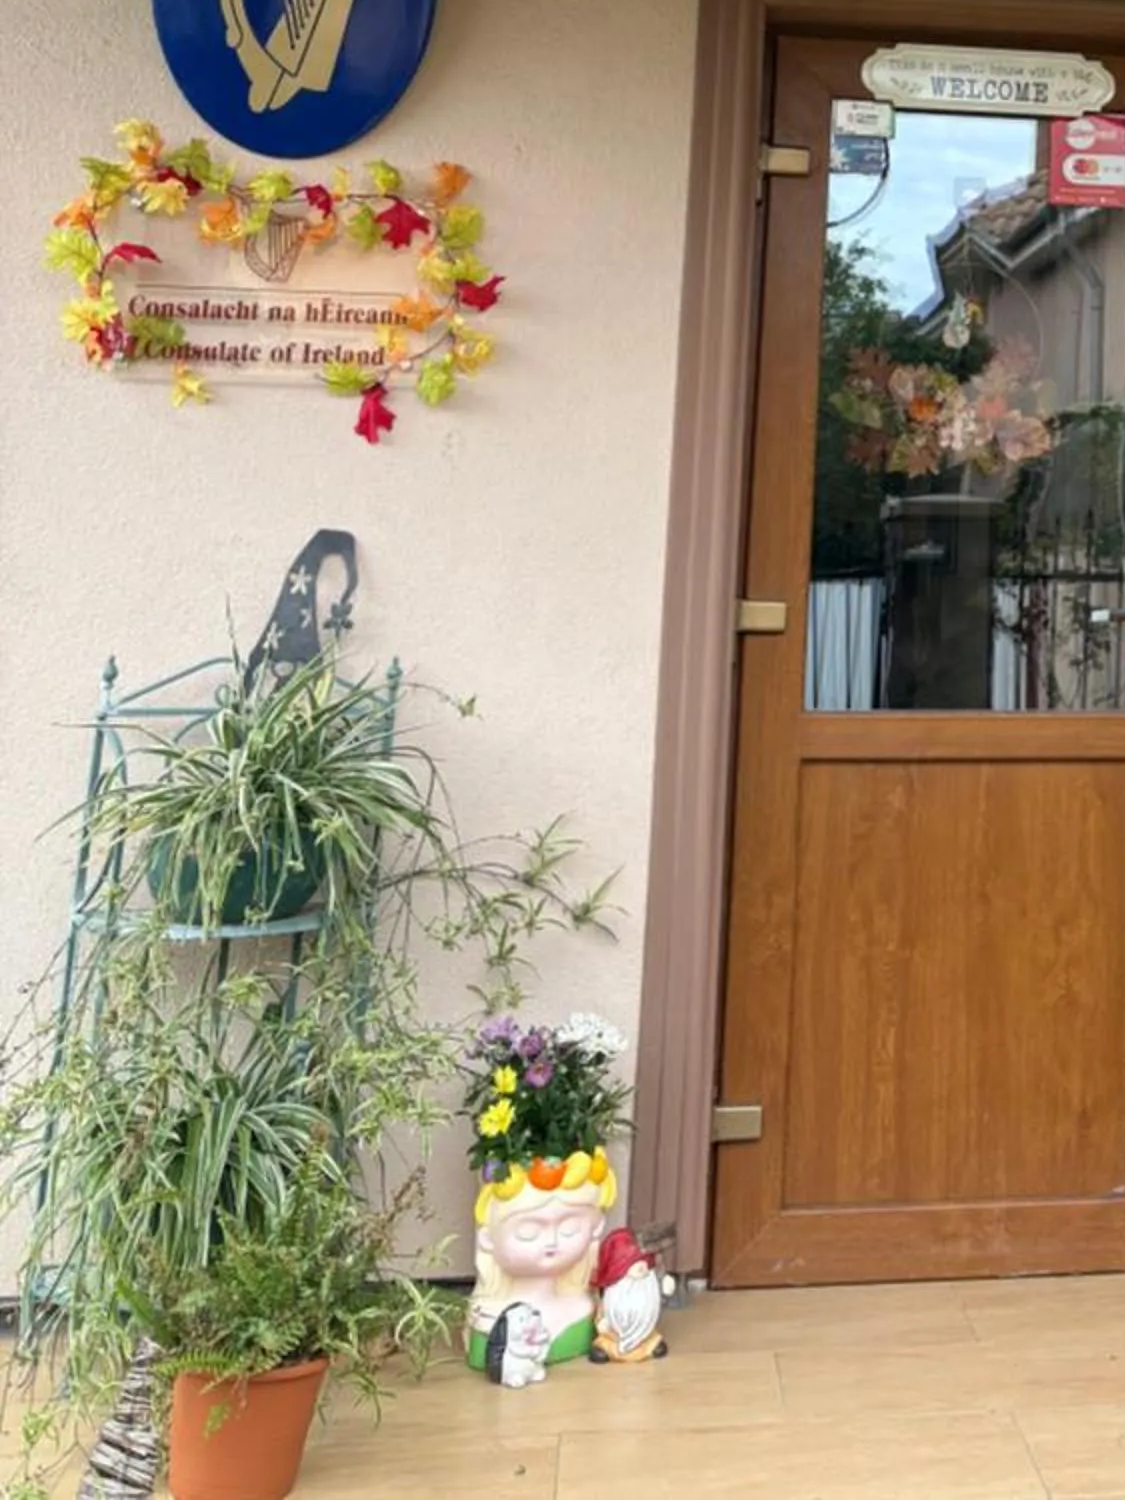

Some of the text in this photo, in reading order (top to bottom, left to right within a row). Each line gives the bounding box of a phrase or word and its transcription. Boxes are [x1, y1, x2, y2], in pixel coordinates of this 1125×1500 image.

[930, 76, 1048, 103] WELCOME
[128, 294, 258, 322] Consalacht
[268, 303, 295, 322] na
[144, 338, 386, 367] Consulate of Ireland
